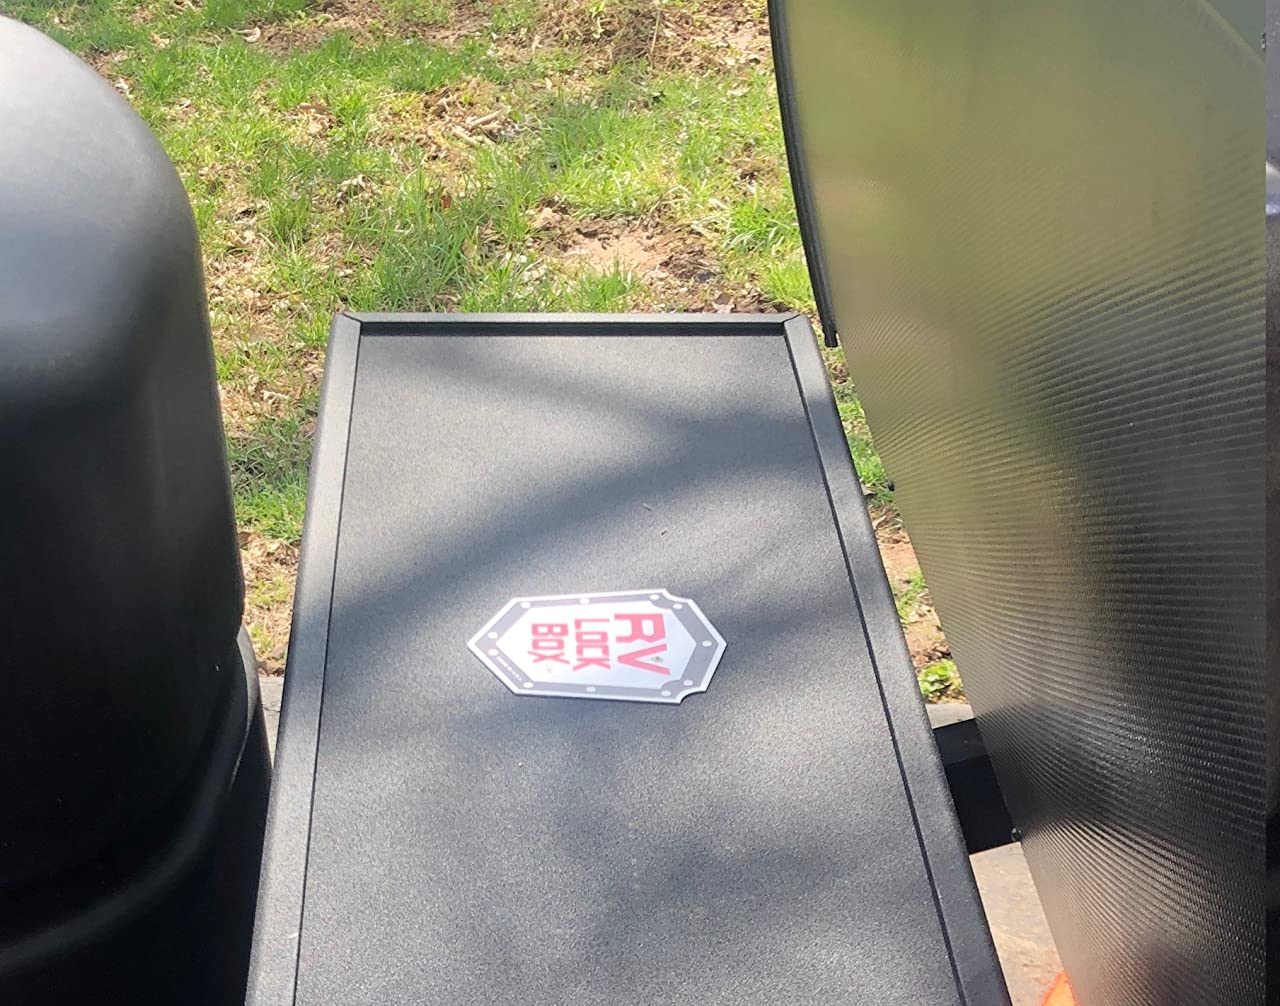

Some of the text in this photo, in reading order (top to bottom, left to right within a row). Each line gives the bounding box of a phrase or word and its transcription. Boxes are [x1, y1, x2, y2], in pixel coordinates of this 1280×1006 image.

[527, 623, 570, 665] BOX
[572, 618, 612, 672] LOCK
[614, 613, 671, 676] RV
